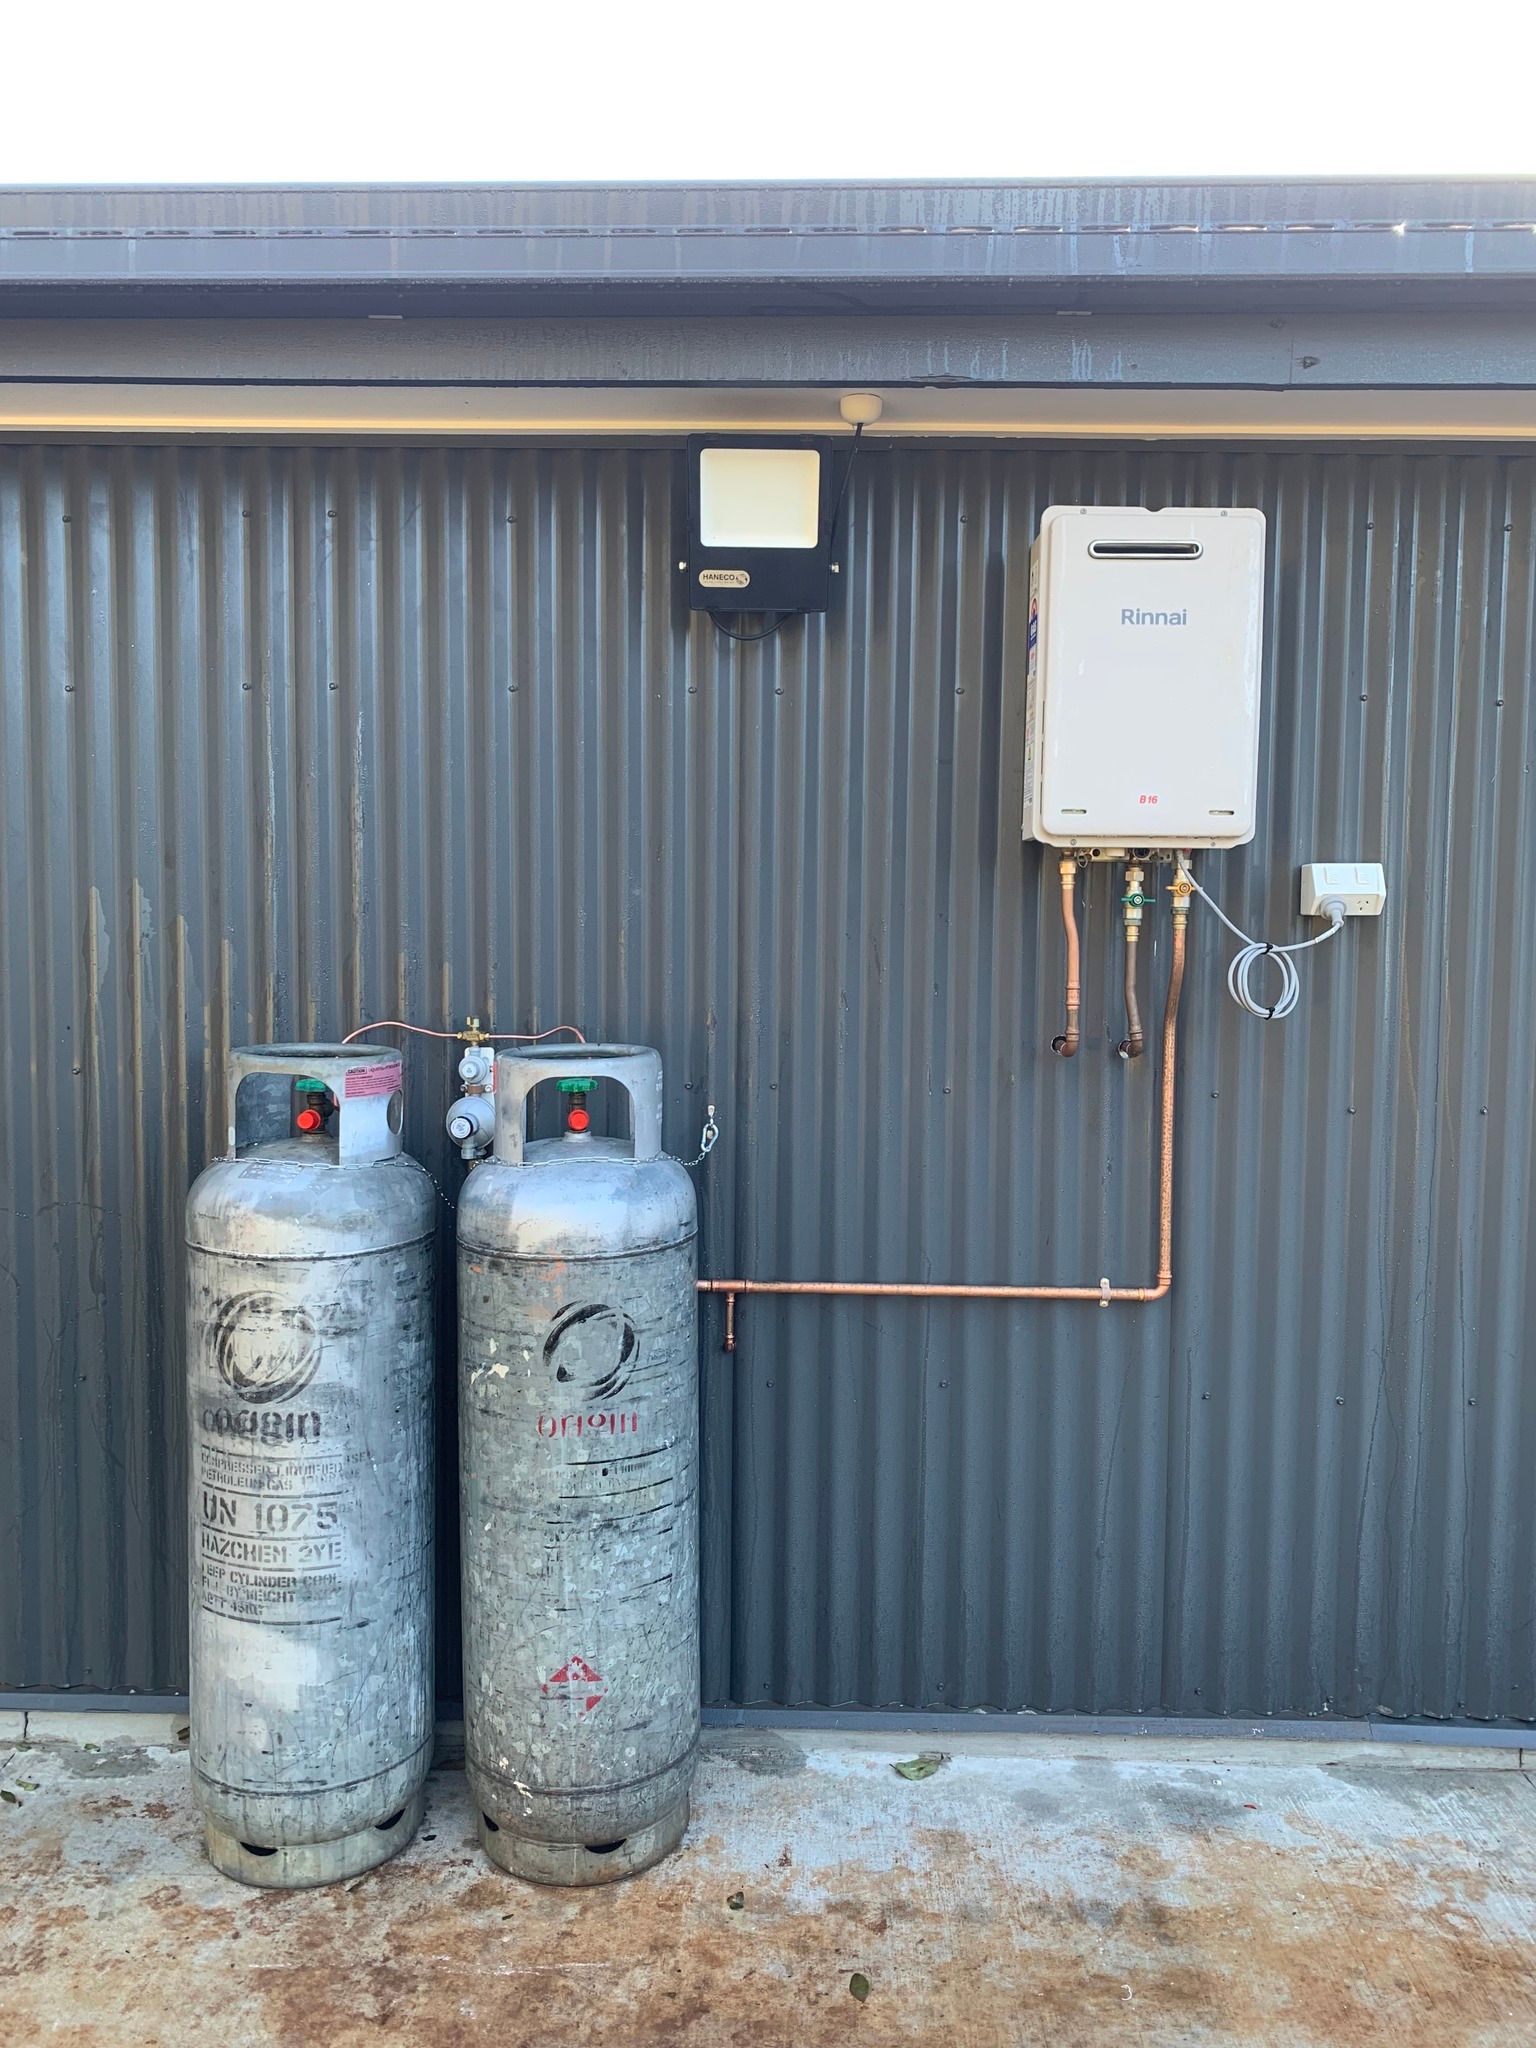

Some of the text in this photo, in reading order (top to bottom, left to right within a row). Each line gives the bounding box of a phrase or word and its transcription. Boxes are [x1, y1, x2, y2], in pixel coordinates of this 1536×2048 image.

[702, 573, 736, 581] HANECO
[1121, 608, 1187, 625] Rinnai
[1139, 795, 1158, 804] B16
[203, 1491, 338, 1532] UN 1075
[201, 1532, 342, 1563] HAZCHEM 2YE
[230, 1571, 297, 1588] CYLINDER
